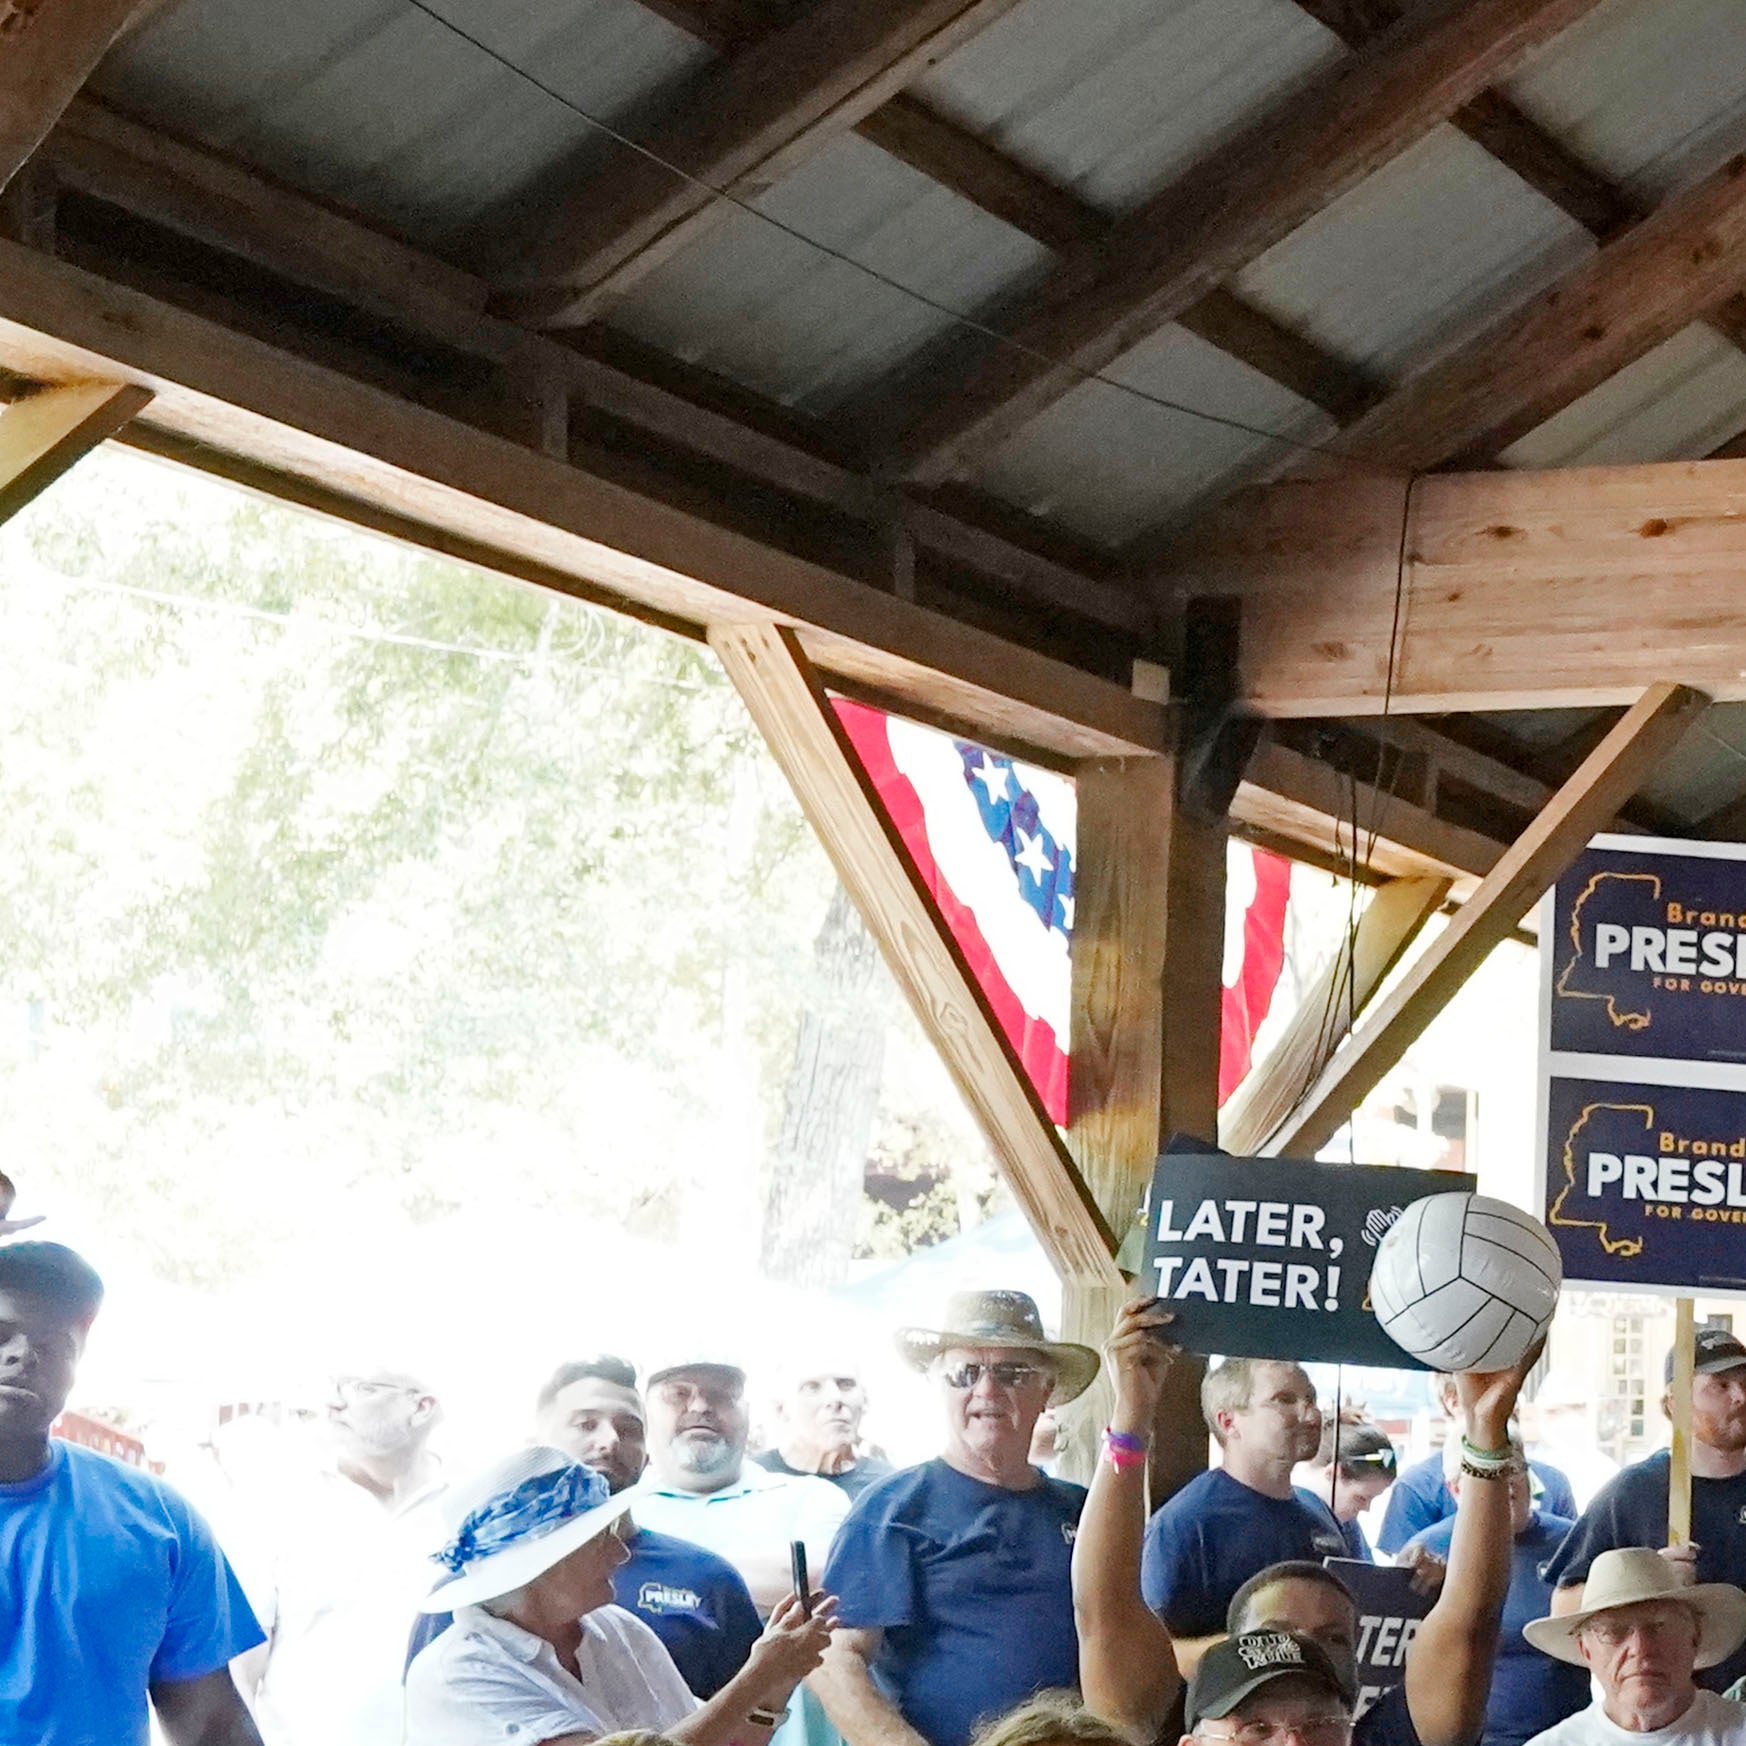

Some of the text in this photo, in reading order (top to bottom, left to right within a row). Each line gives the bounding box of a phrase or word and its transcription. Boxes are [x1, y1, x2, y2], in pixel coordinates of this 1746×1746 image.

[1654, 977, 1691, 992] FOR
[1645, 1204, 1682, 1219] FOR
[1157, 1200, 1344, 1259] LATER,
[1153, 1256, 1341, 1312] TATER!
